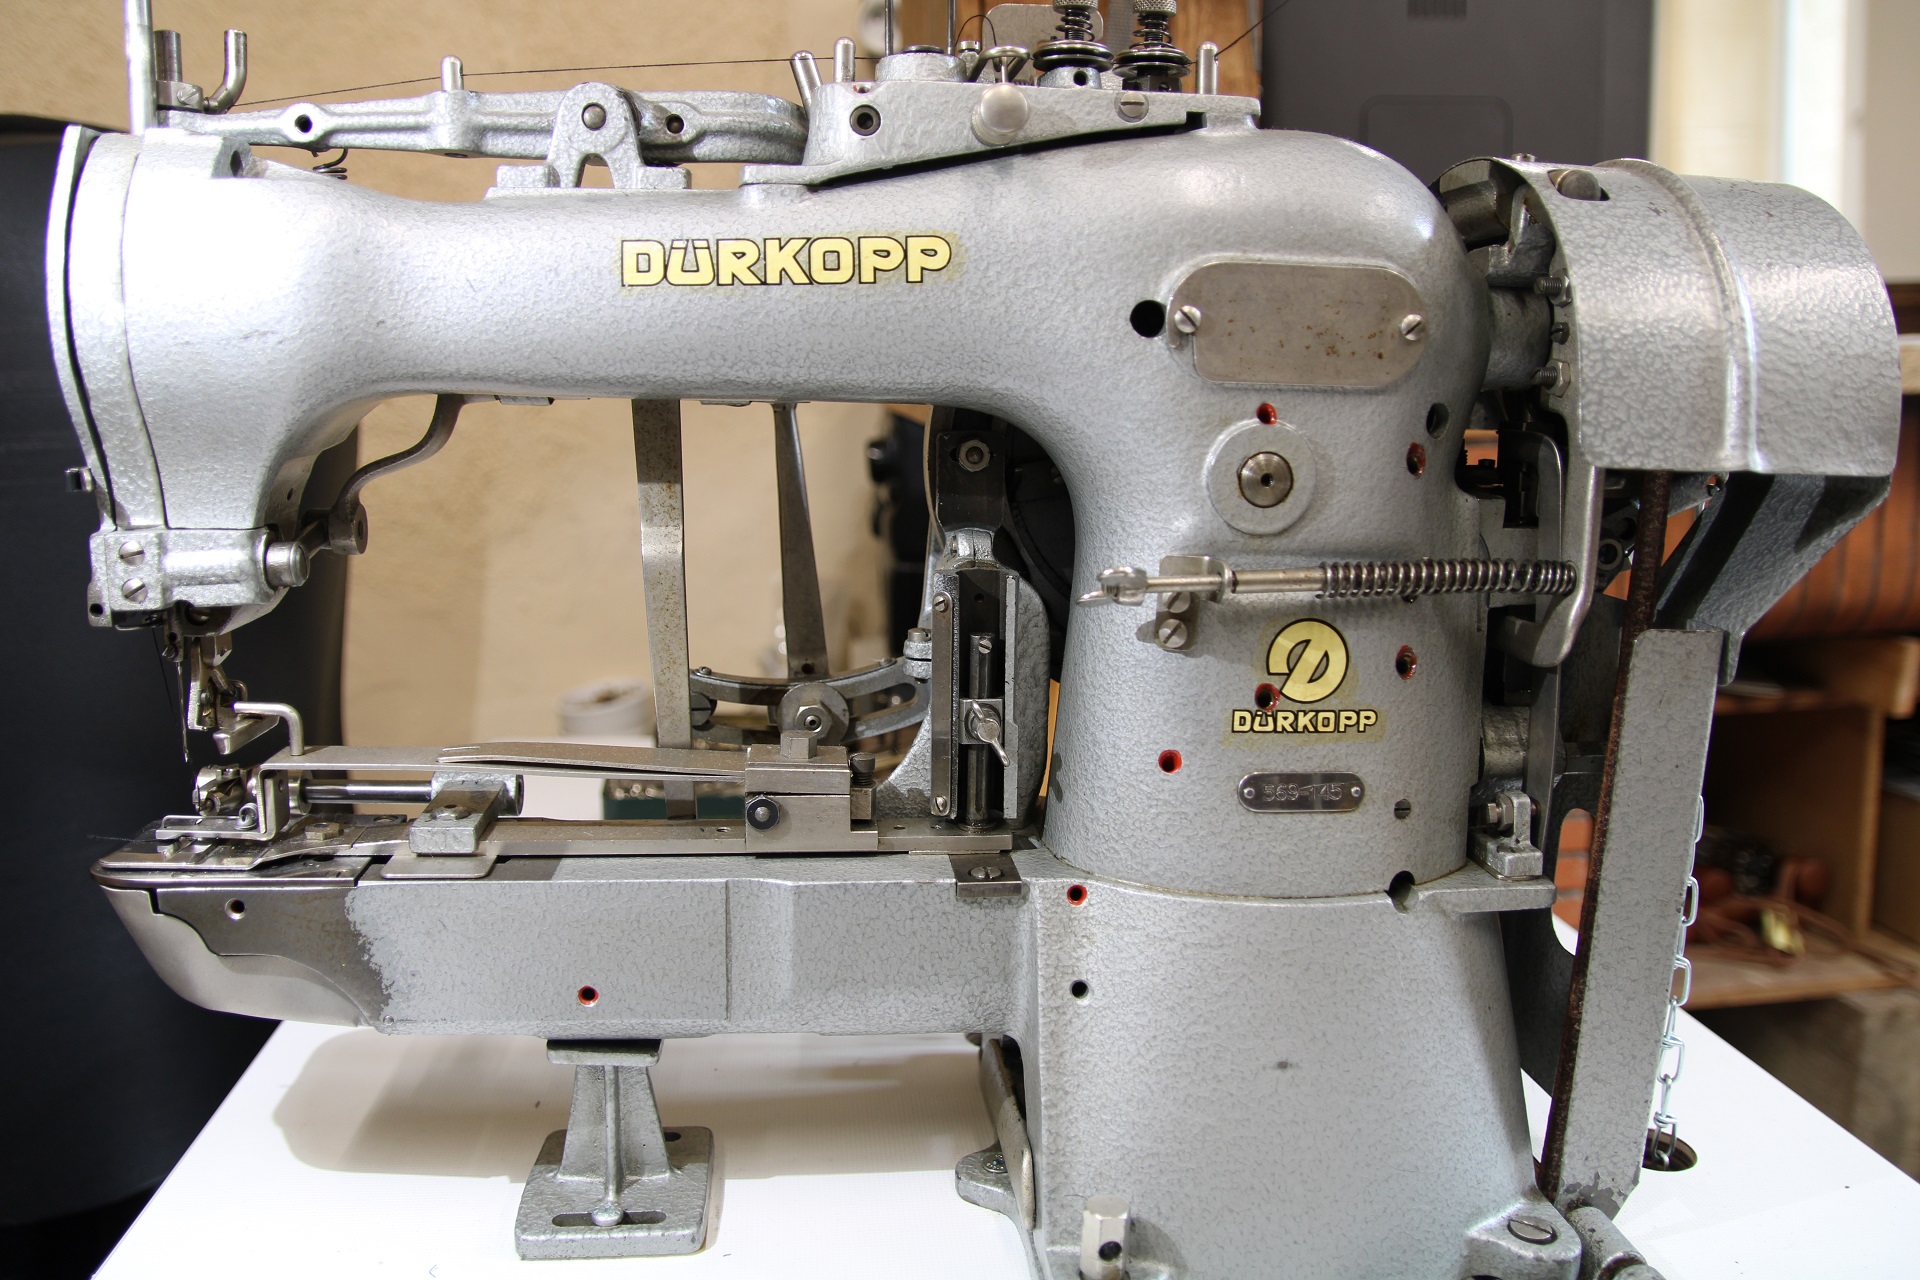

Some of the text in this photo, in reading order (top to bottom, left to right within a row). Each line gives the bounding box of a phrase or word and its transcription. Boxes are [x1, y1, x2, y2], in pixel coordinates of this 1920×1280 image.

[621, 235, 952, 287] DÜRKOPP
[1232, 709, 1378, 733] DÜRKOPP
[1263, 783, 1343, 802] 569-145
